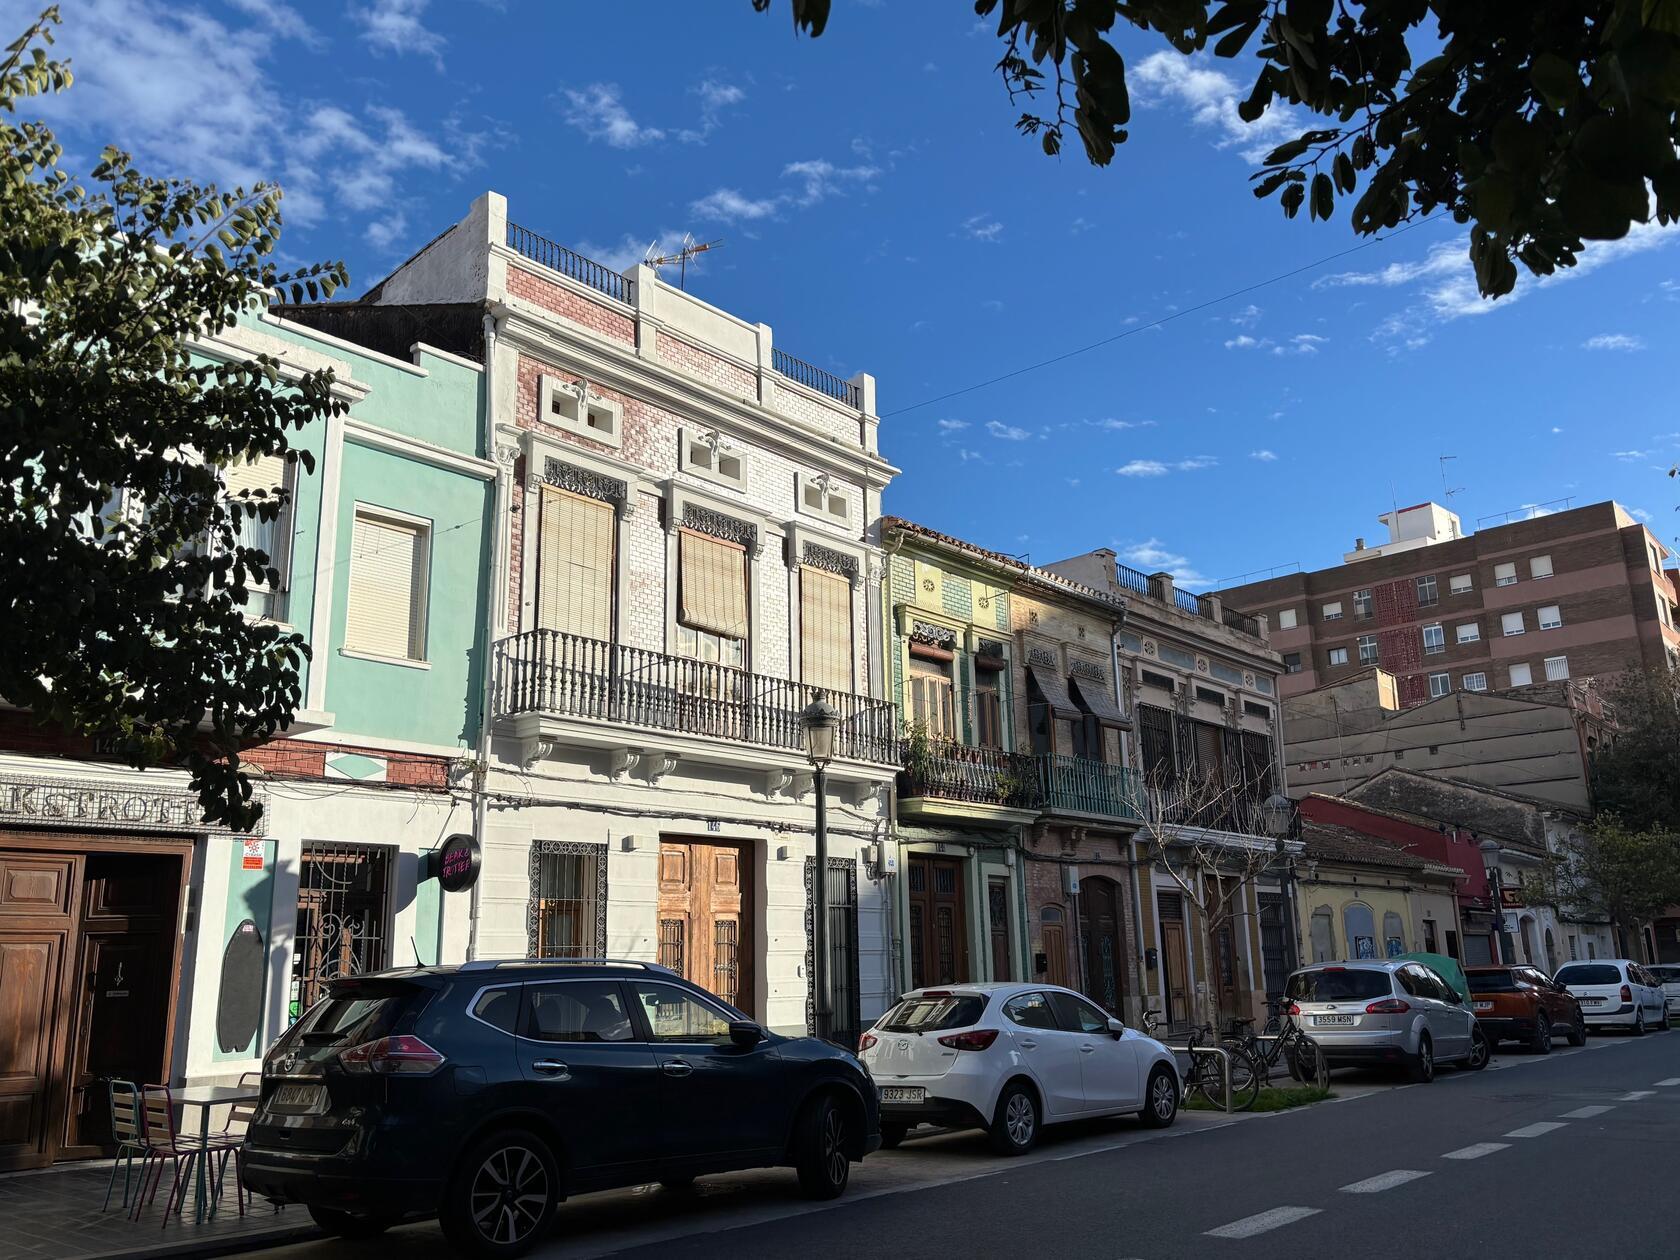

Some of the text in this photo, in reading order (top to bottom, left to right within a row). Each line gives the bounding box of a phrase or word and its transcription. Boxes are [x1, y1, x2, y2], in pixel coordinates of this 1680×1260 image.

[1318, 1015, 1352, 1024] 3559 MSN
[883, 1089, 922, 1099] 9323 JSR
